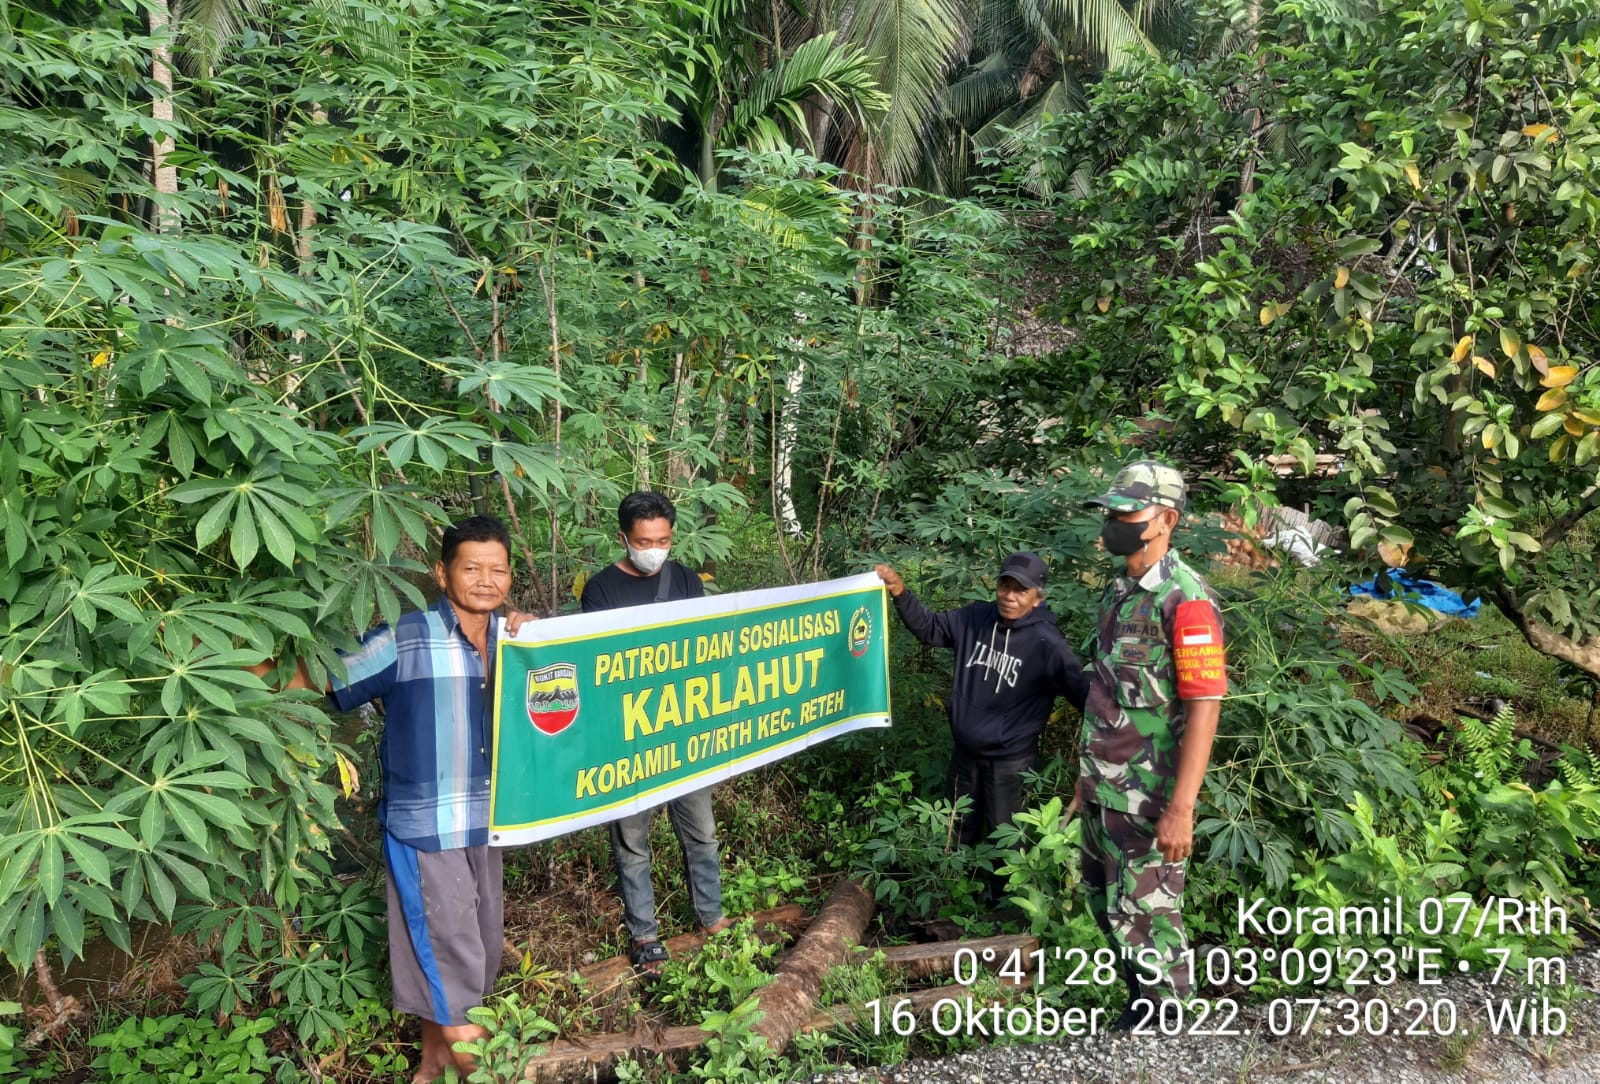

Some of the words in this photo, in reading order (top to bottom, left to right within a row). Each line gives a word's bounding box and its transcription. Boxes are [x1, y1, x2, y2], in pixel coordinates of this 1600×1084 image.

[594, 638, 690, 686] PATROLI
[695, 629, 734, 665] DAN
[738, 609, 841, 655] SOSIALISASI
[622, 648, 825, 742] KARLAHUT
[575, 742, 682, 800] KORAMIL
[687, 719, 752, 763] 07/RTH
[757, 707, 795, 741] KEC.
[799, 688, 845, 726] RETEH
